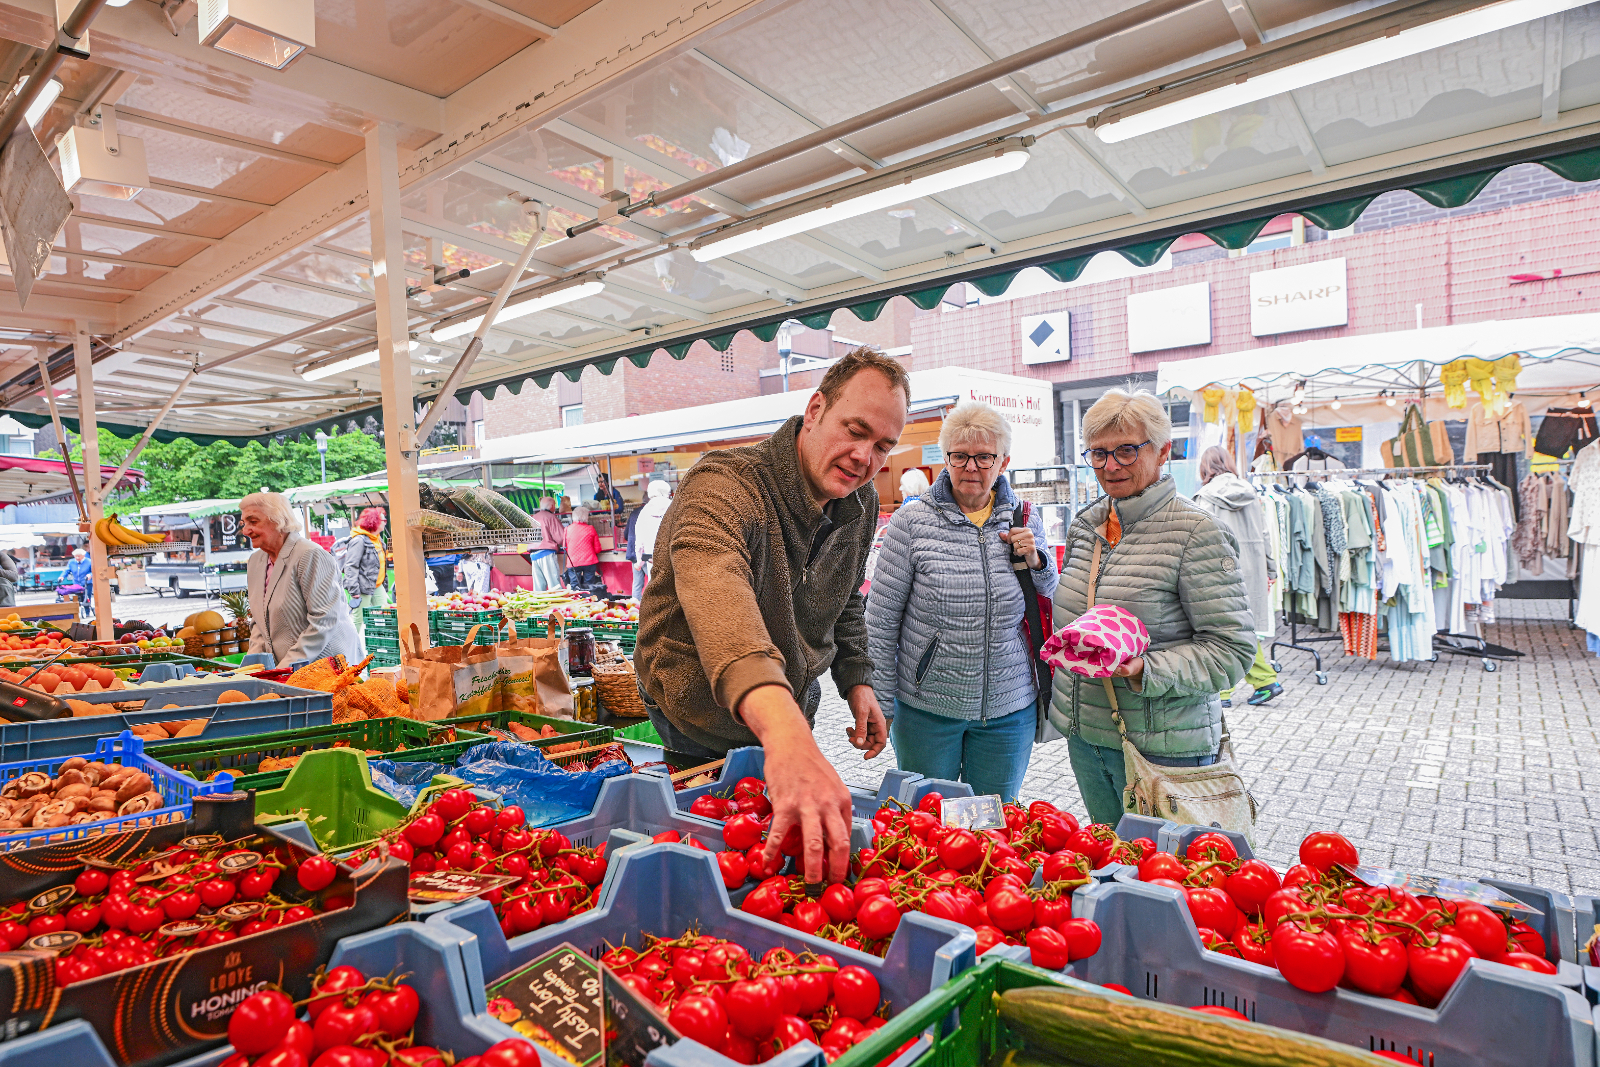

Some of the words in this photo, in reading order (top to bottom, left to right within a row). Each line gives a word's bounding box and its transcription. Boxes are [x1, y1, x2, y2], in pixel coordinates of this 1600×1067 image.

[1257, 285, 1341, 308] SHARP
[1026, 395, 1041, 411] Hof
[209, 965, 253, 993] LOOYE
[206, 1002, 240, 1021] TOMA
